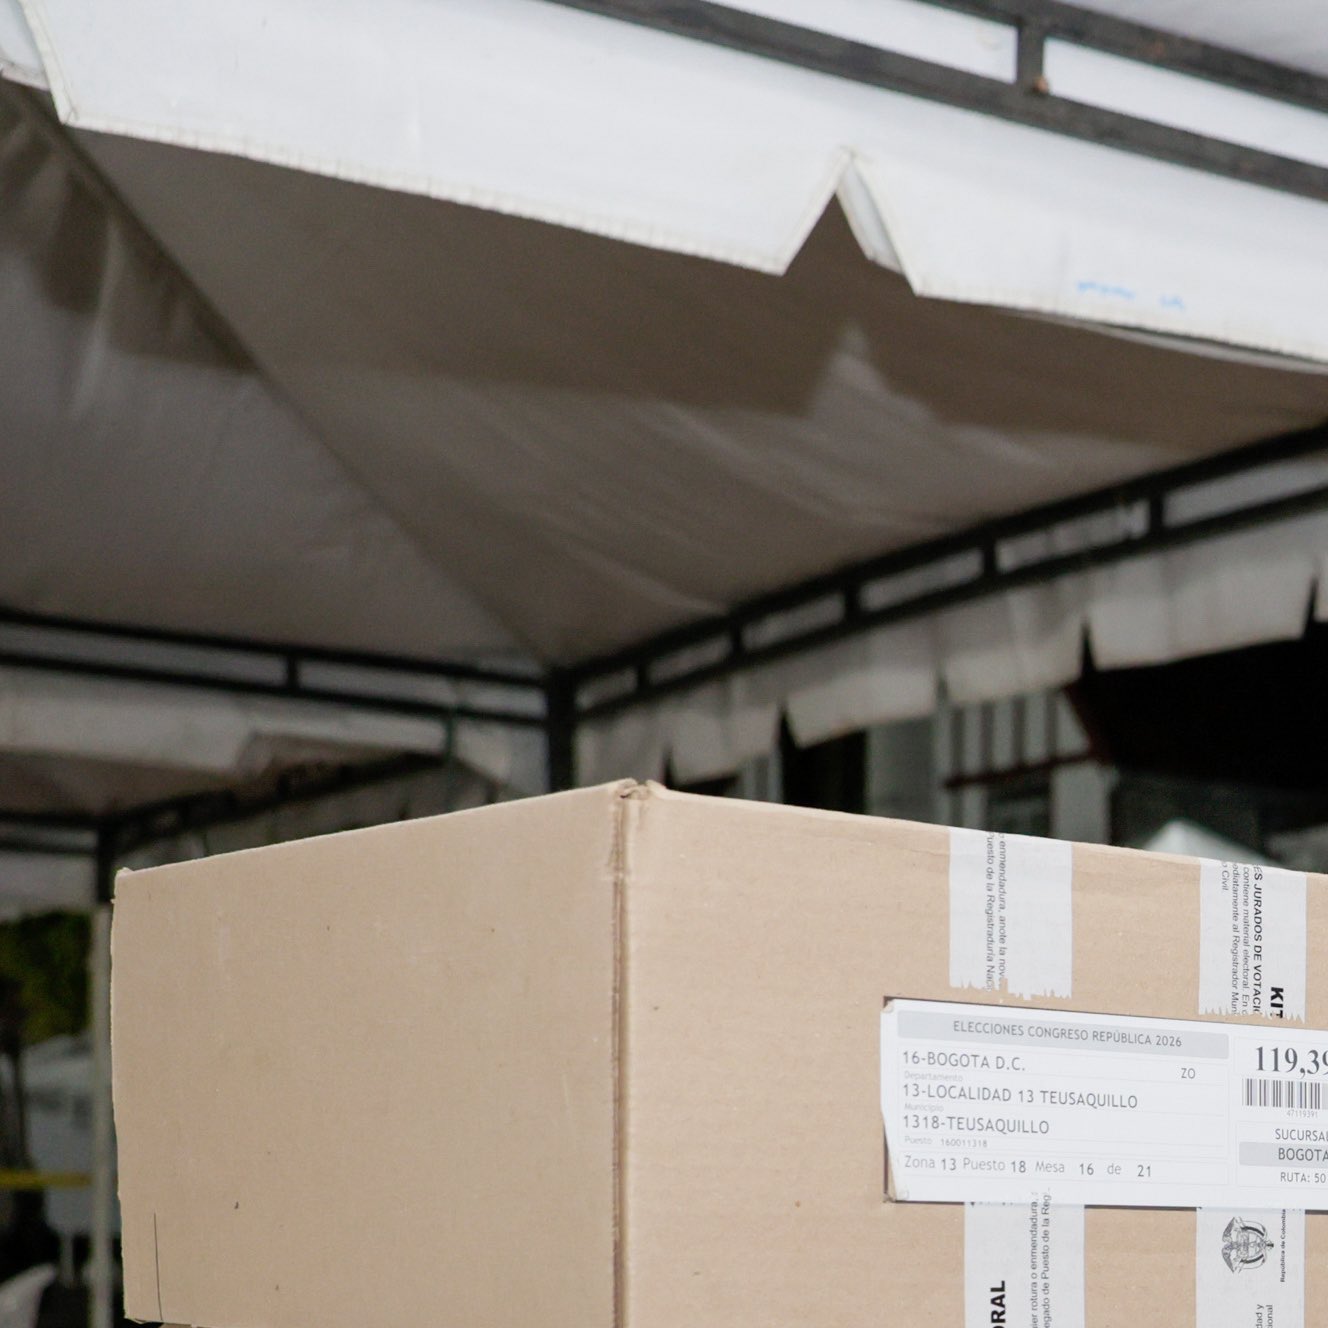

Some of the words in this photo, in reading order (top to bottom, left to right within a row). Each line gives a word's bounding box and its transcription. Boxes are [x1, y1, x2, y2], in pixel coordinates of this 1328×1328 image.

[998, 841, 1008, 912] enmendadura,
[1253, 884, 1263, 941] JURADOS
[985, 894, 995, 962] Registraduría
[1253, 945, 1263, 961] DE
[953, 1019, 1024, 1036] ELECCIONES
[1028, 1025, 1088, 1041] CONGRESO
[1092, 1029, 1152, 1046] REPÚBLICA
[1155, 1035, 1181, 1048] 2026
[903, 1050, 990, 1069] 16-BOGOTA
[996, 1056, 1025, 1071] D.C.
[903, 1082, 1011, 1102] 13-LOCALIDAD
[1018, 1089, 1034, 1103] 13
[1040, 1090, 1138, 1110] TEUSAQUILLO
[1286, 1109, 1318, 1118] 47119391
[903, 1114, 1049, 1136] 1318-TEUSAQUILLO
[940, 1138, 987, 1148] 160011318
[904, 1156, 935, 1170] Zona
[941, 1158, 957, 1171] 13
[963, 1158, 1005, 1172] Puesto
[1010, 1160, 1026, 1173] 18
[1035, 1160, 1064, 1173] Mesa
[1079, 1162, 1094, 1176] 16
[1107, 1162, 1121, 1175] de
[1136, 1164, 1151, 1178] 21
[1280, 1172, 1310, 1183] RUTA:
[1314, 1173, 1326, 1183] 50
